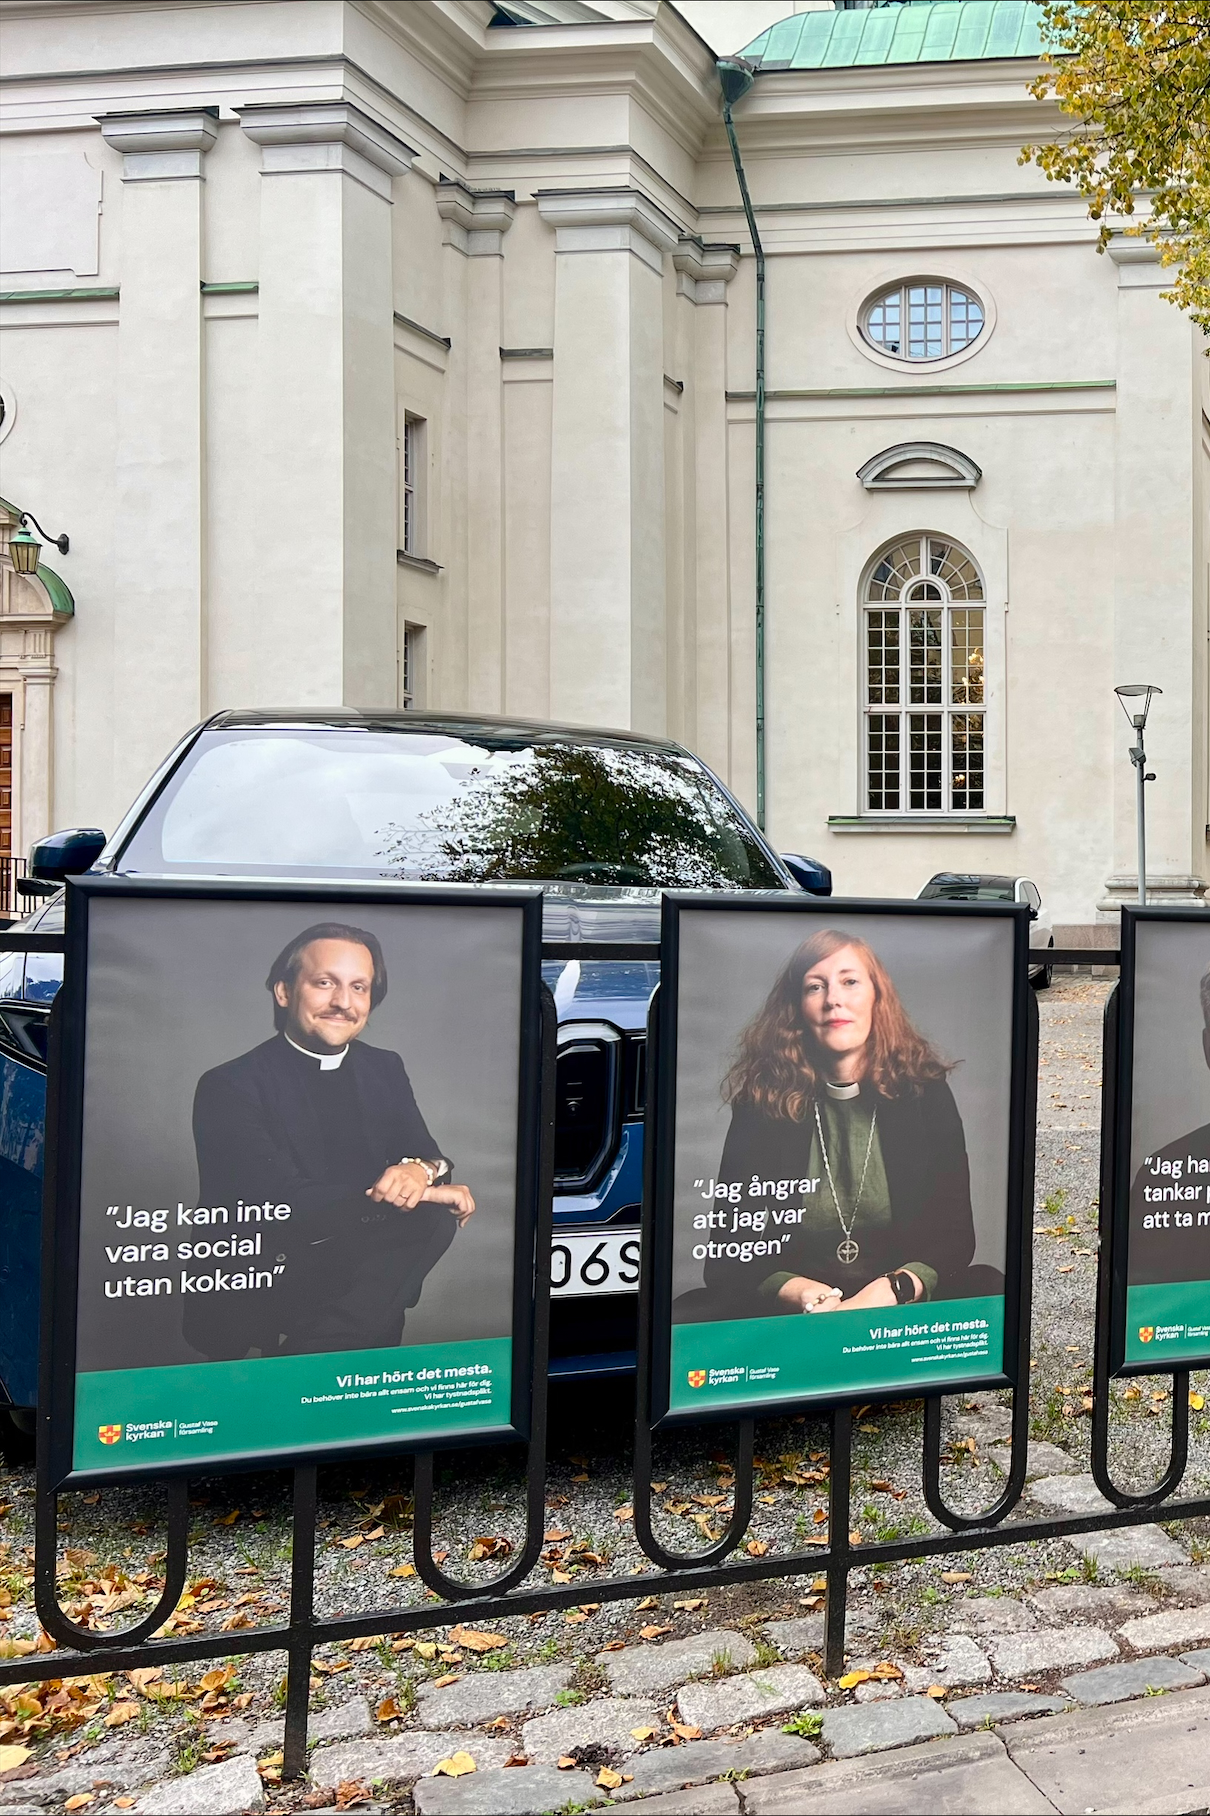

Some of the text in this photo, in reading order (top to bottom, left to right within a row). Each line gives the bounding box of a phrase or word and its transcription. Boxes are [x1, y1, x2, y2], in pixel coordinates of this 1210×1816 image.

[748, 1175, 820, 1200] ångrar
[1143, 1182, 1202, 1202] tankar
[177, 1203, 228, 1225] kan
[237, 1200, 291, 1222] inte
[693, 1207, 806, 1232] att jag var
[1143, 1211, 1170, 1229] att
[1174, 1211, 1192, 1227] ta
[105, 1233, 261, 1263] vara social
[105, 1276, 172, 1298] utan
[869, 1319, 989, 1339] Vi har hört det mesta.
[336, 1364, 492, 1387] Vi har hört det mesta.
[708, 1375, 738, 1386] kyrkan
[709, 1366, 745, 1377] Svenska
[126, 1420, 172, 1432] Svenska
[126, 1430, 164, 1442] kyrkan
